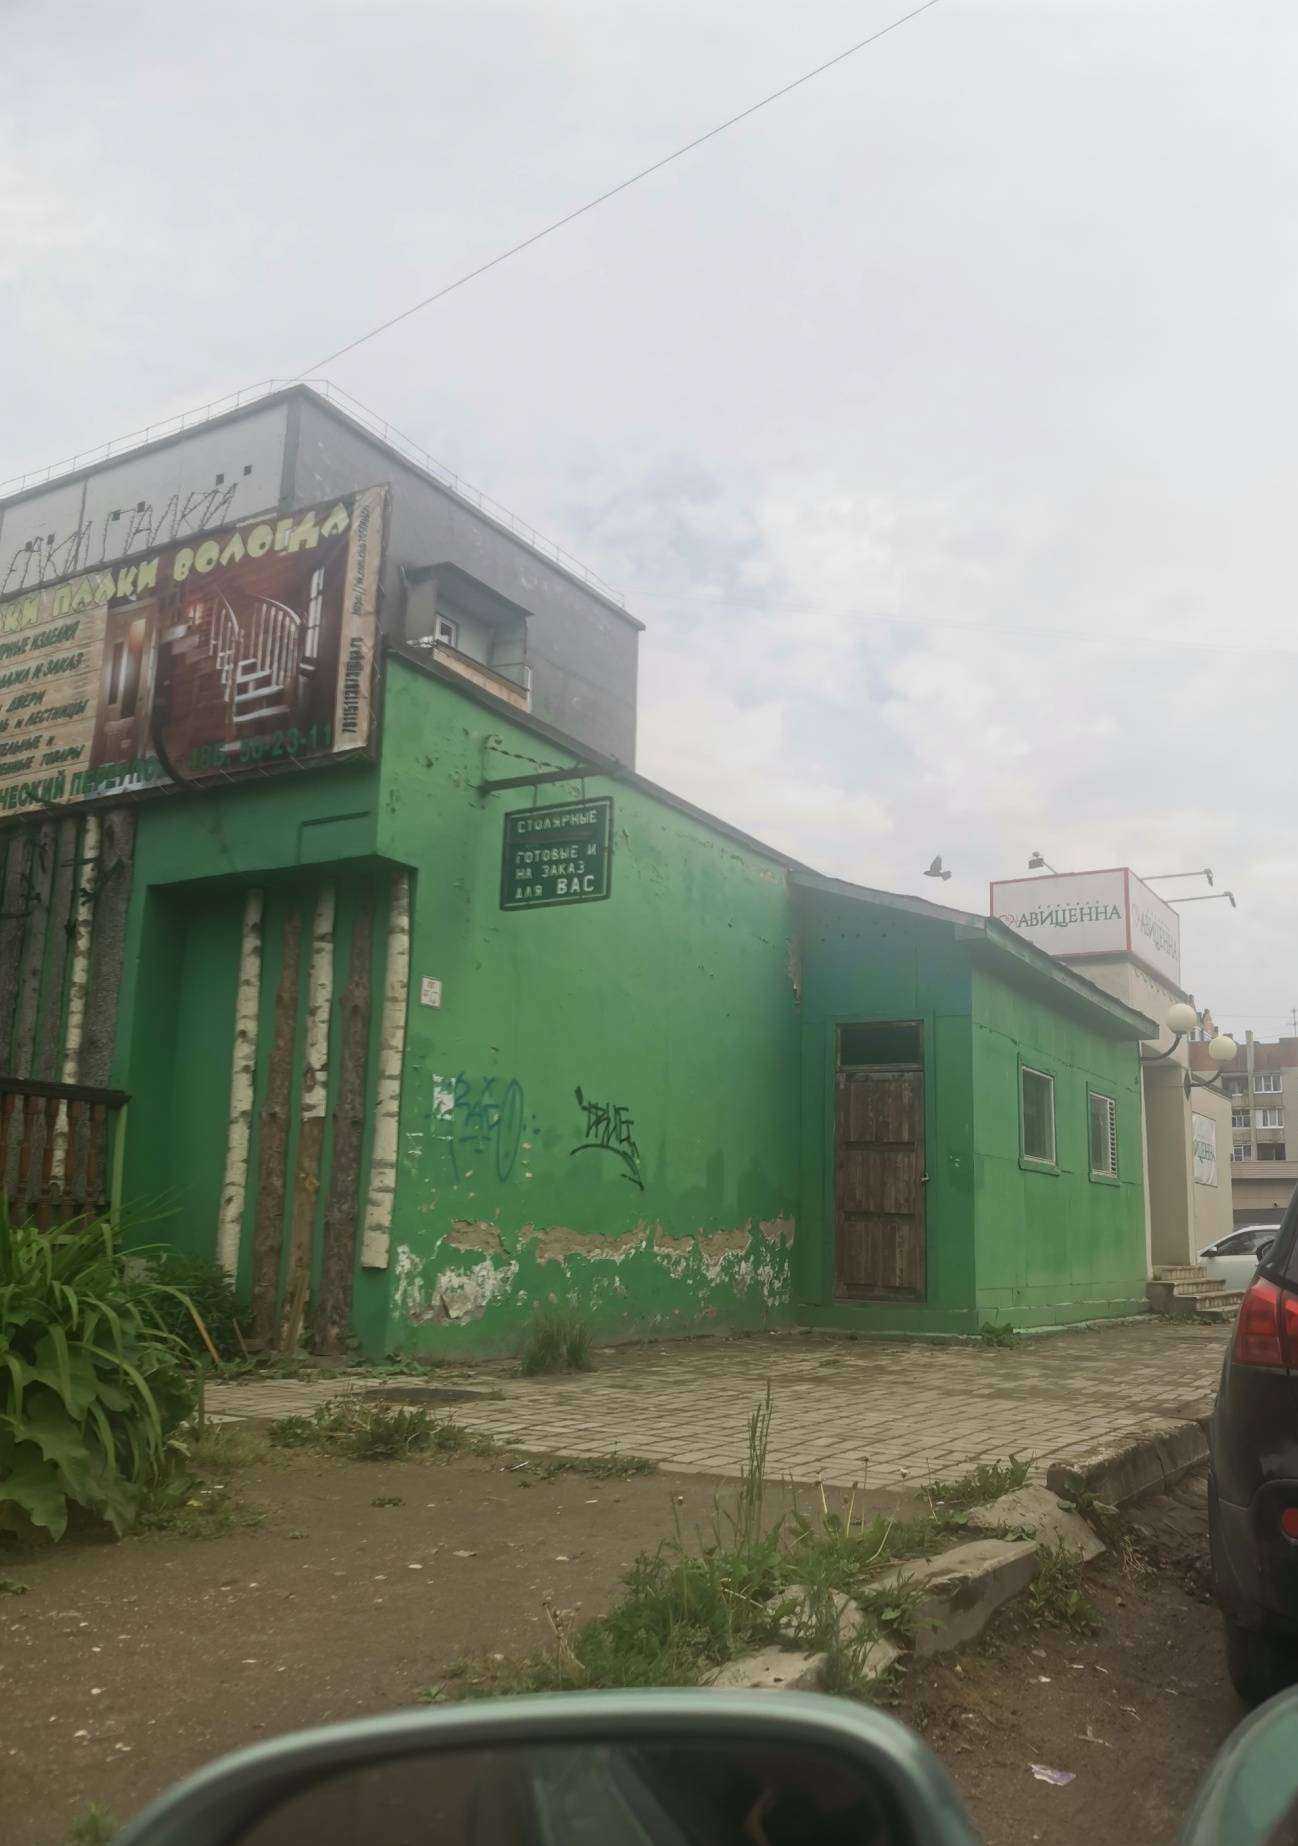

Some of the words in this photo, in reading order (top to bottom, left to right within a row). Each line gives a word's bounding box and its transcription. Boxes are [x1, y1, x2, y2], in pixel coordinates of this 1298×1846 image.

[53, 555, 160, 619] ПАЛКИ
[173, 502, 350, 582] ВОЛОГДА
[517, 810, 598, 833] СТОЛЯРНЫЕ
[515, 845, 579, 864] ГОТОВЫЕ
[587, 843, 598, 856] И
[515, 867, 532, 880] НА
[541, 860, 585, 878] ЗАКАЗ
[515, 885, 543, 899] ДЛЯ
[556, 875, 595, 895] ВАС
[1016, 903, 1122, 928] АВИЦЕННА
